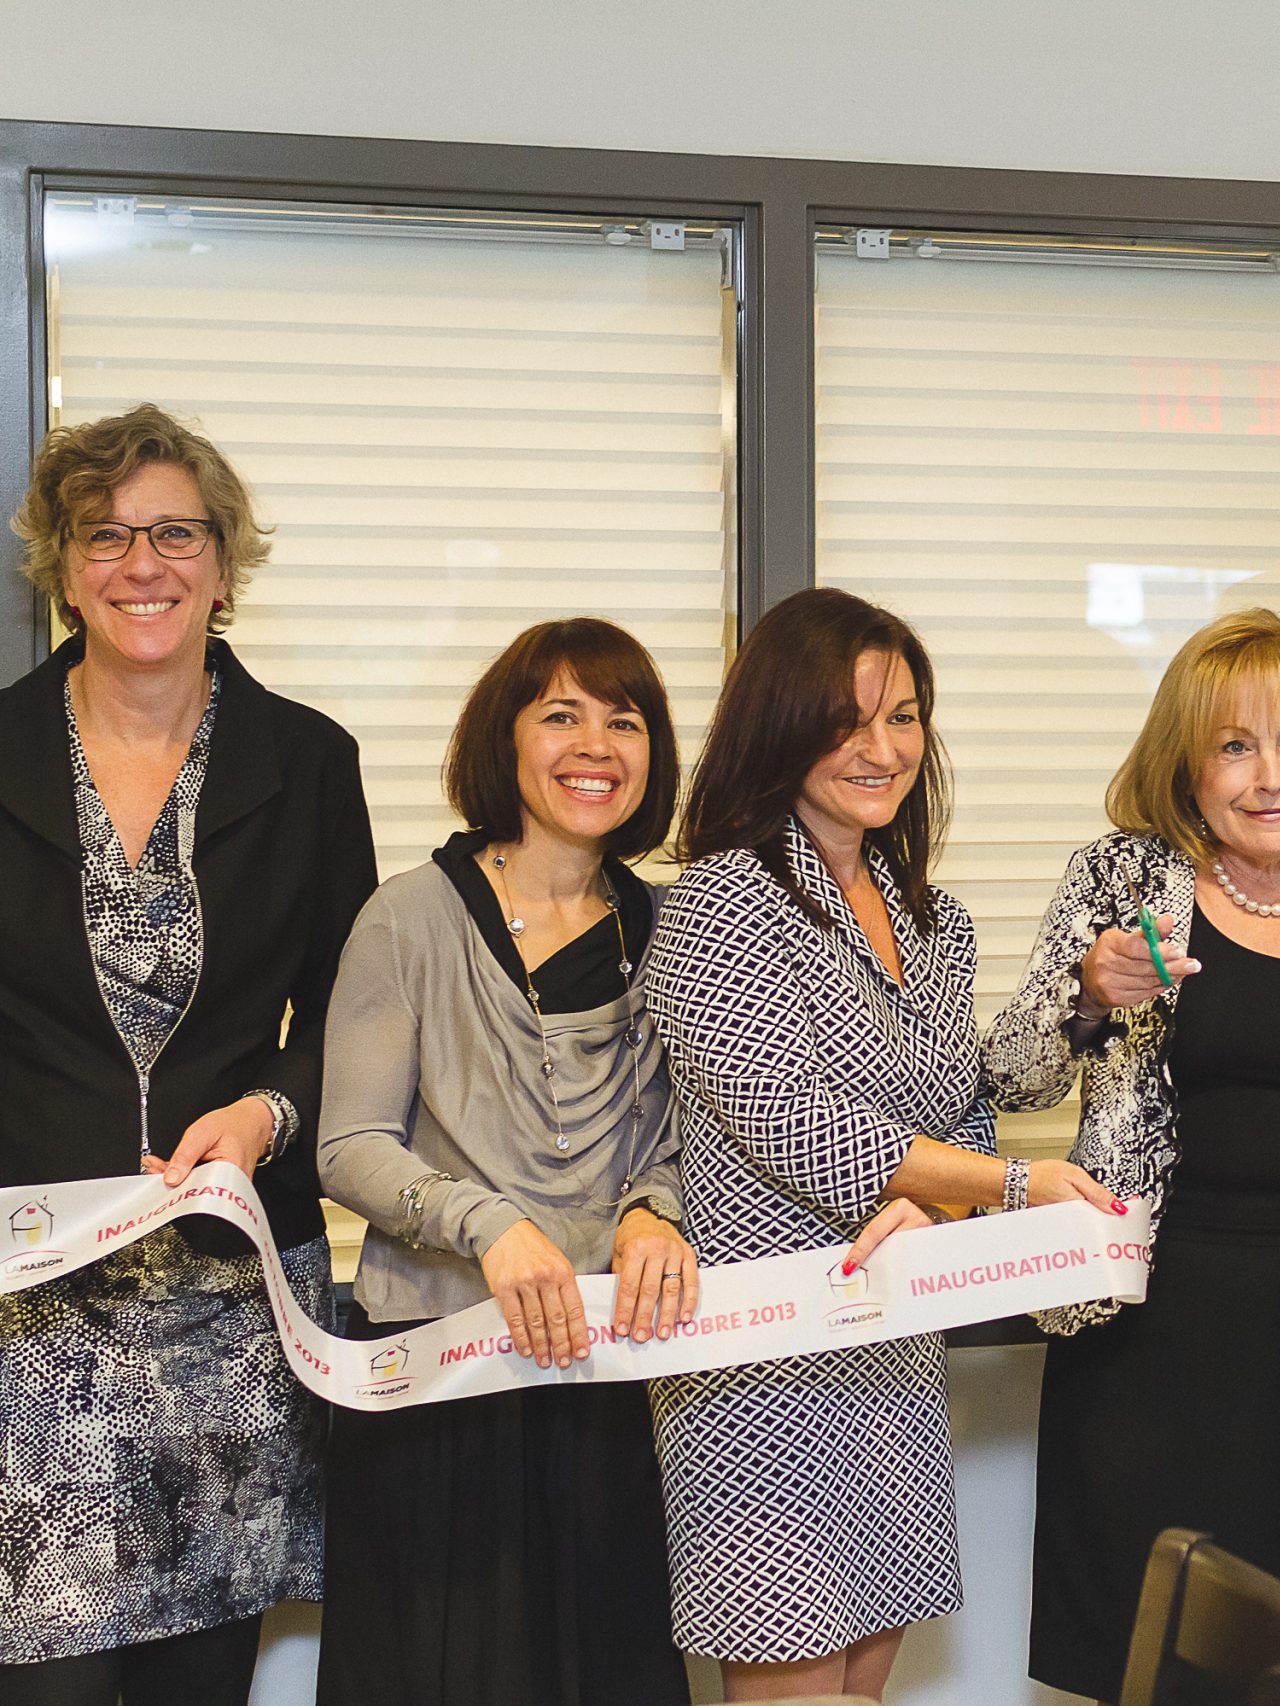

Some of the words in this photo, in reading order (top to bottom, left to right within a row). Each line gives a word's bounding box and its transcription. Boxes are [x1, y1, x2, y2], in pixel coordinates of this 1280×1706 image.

[97, 1186, 259, 1243] INAUGURATION
[910, 1247, 1087, 1297] INAUGURATION
[294, 1338, 332, 1376] 2013
[438, 1324, 618, 1367] INAUGON
[748, 1301, 797, 1327] 2013
